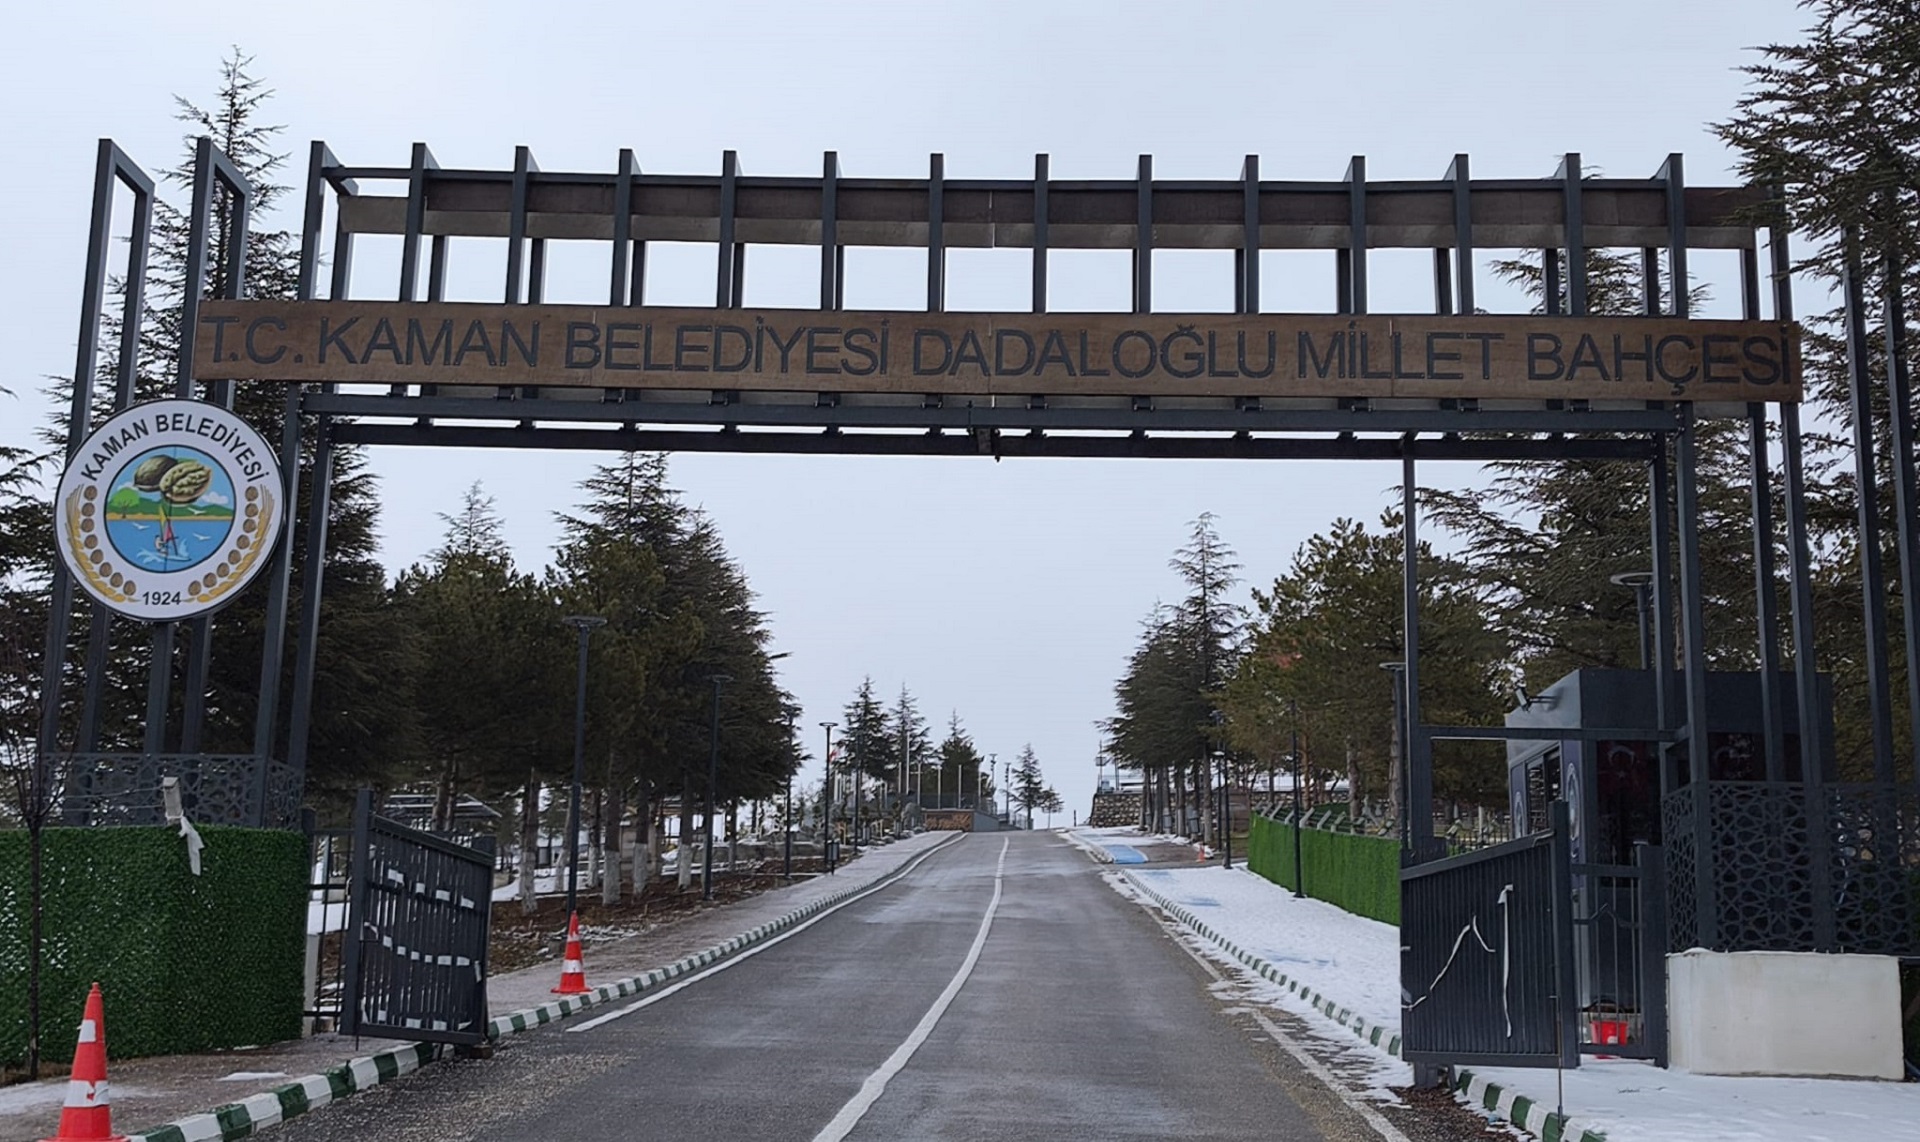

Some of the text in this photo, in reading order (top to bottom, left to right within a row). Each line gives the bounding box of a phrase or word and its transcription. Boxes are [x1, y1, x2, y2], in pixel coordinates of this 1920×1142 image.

[564, 316, 890, 376] BELEDİYESİ
[912, 322, 1277, 379] DADALOĞLU
[1297, 320, 1505, 381] MİLLET
[1526, 324, 1792, 396] BAHÇESİ
[80, 413, 270, 483] KAMAN BELEDİYESİ
[142, 591, 182, 606] 1924
